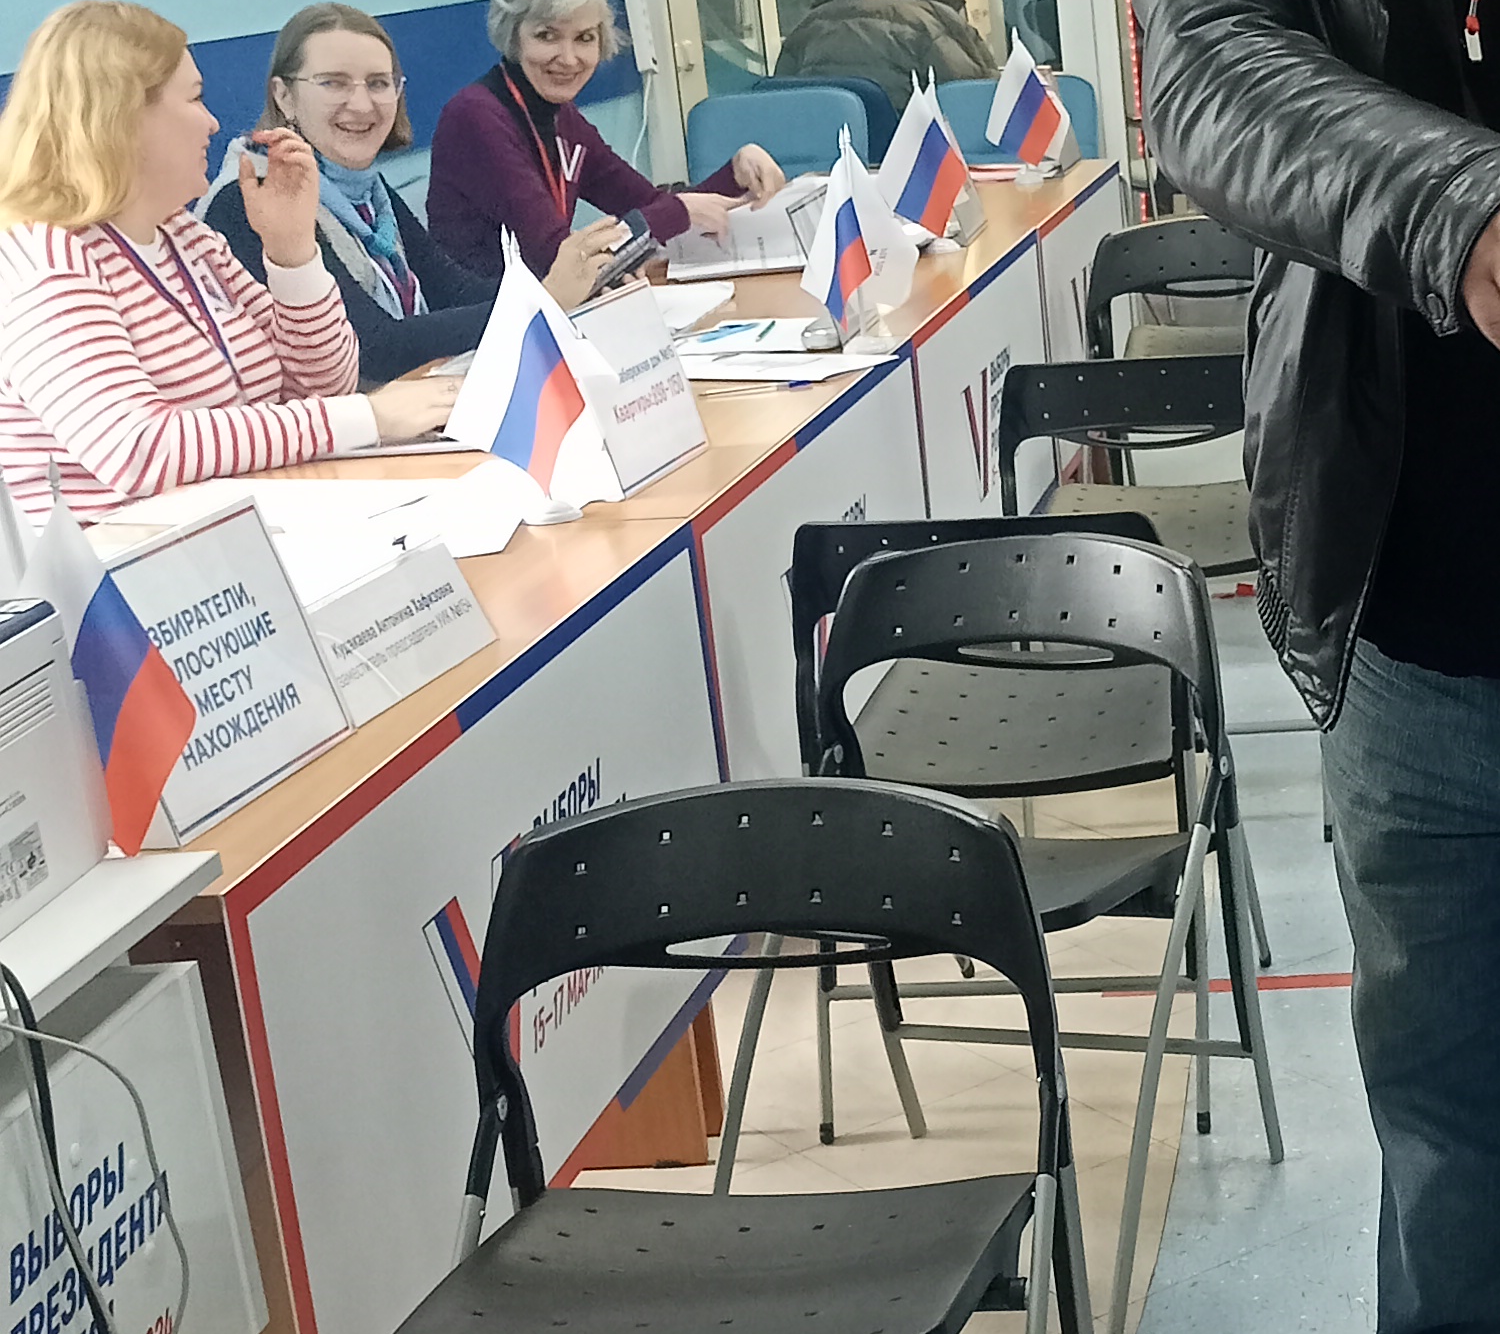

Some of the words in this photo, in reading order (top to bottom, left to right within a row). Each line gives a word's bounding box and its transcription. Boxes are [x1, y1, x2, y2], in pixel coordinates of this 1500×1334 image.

[148, 582, 256, 649] ЗБИРАТЕЛИ,
[173, 611, 276, 684] ЛОСУЮЩИЕ
[195, 664, 254, 717] МЕСТУ
